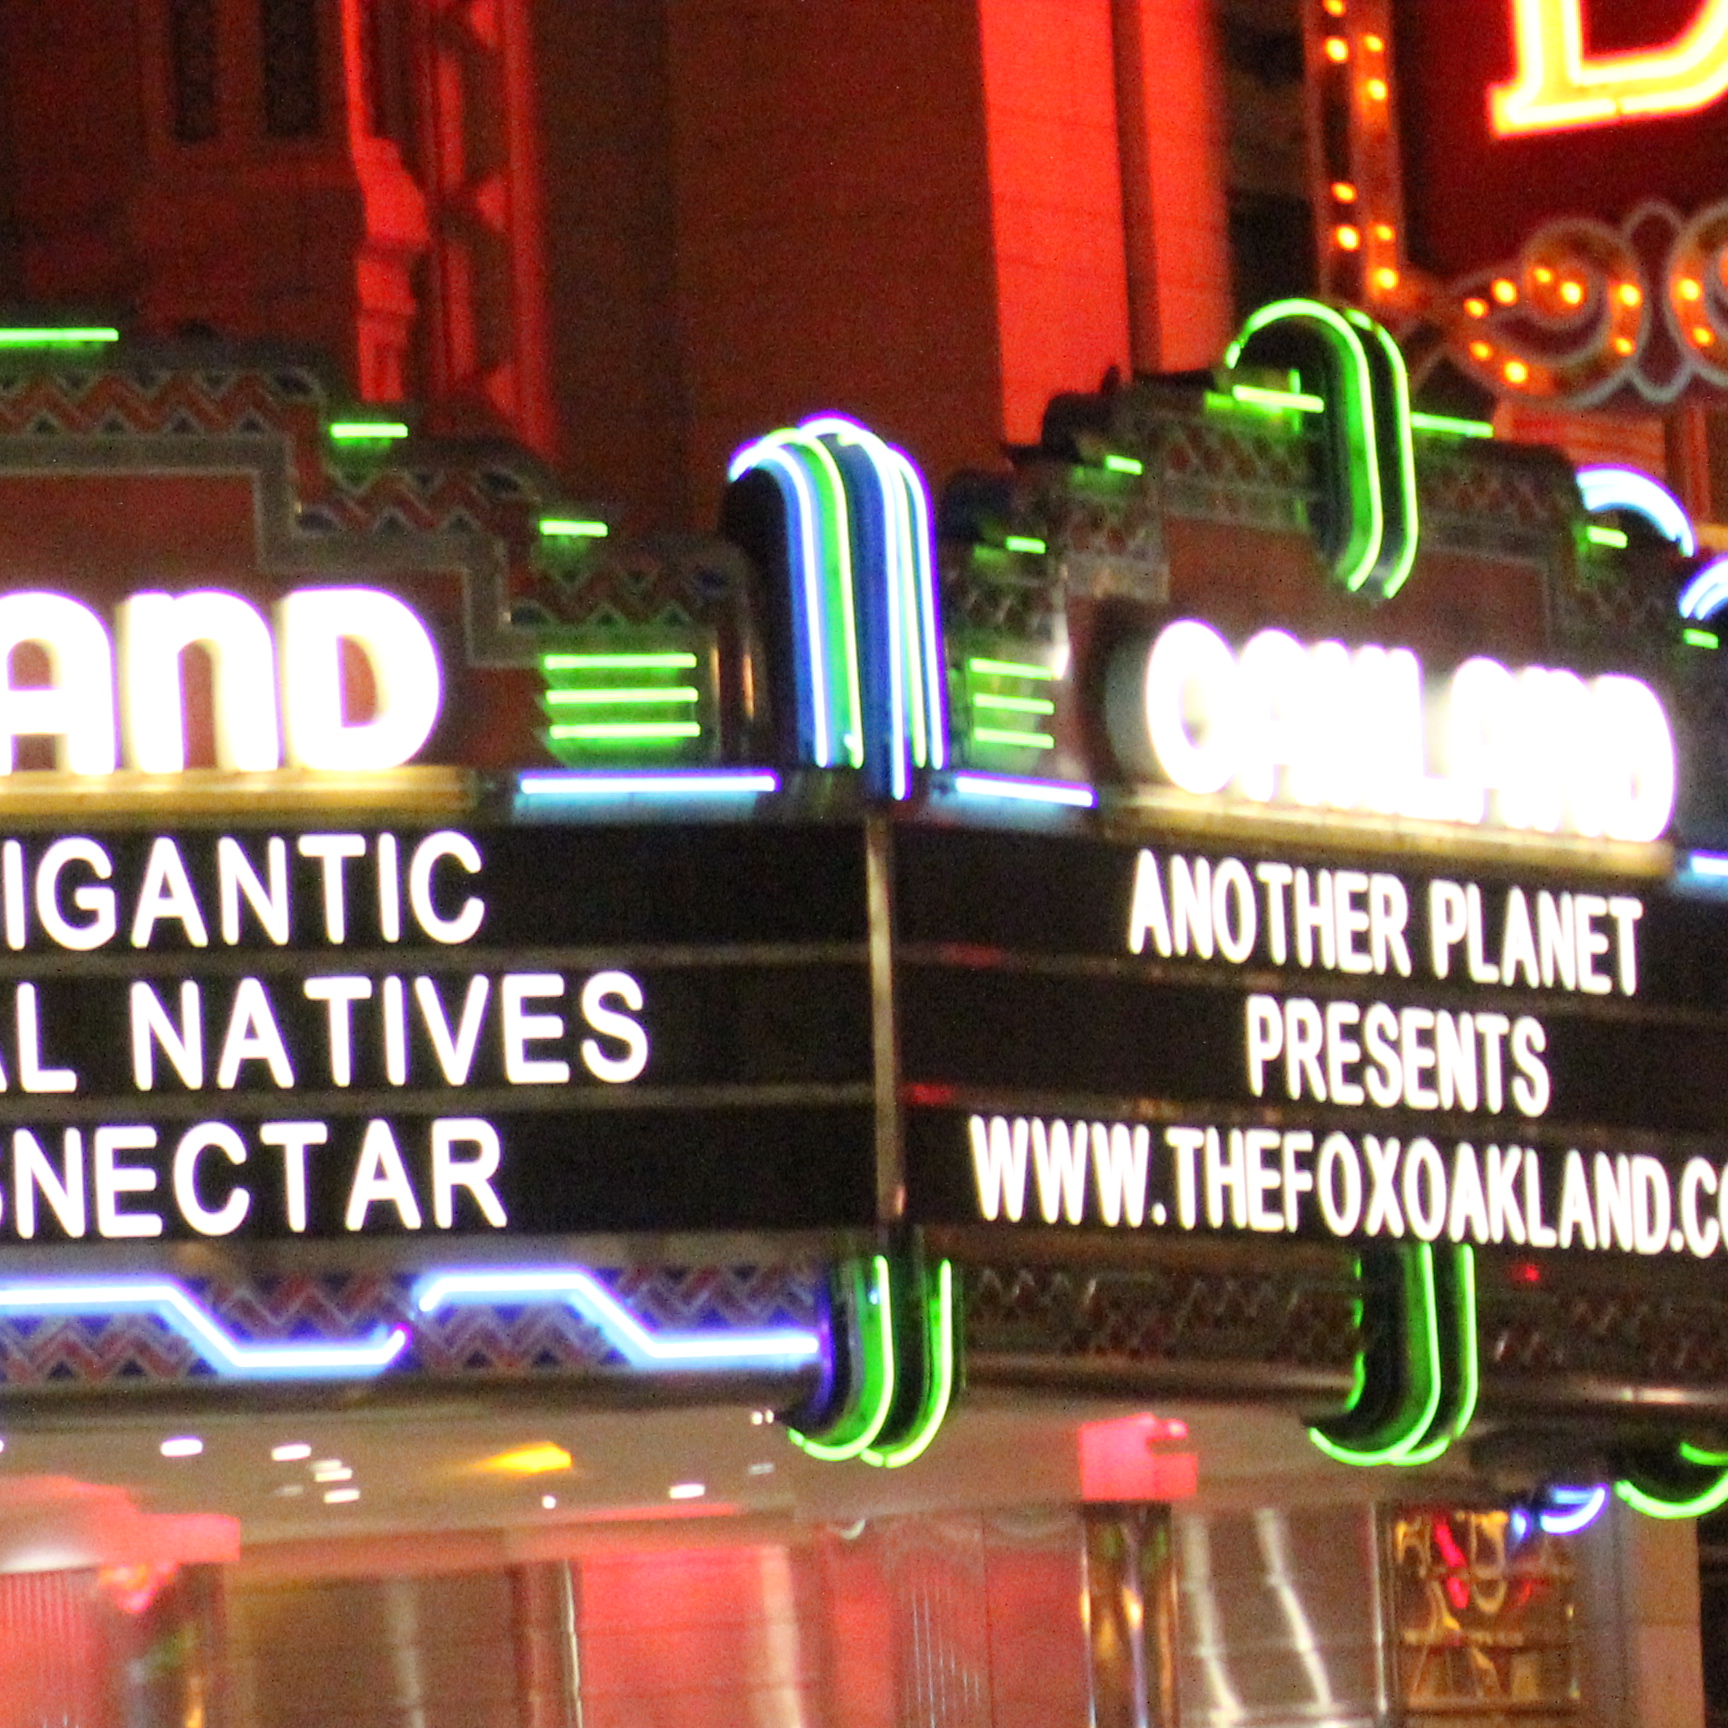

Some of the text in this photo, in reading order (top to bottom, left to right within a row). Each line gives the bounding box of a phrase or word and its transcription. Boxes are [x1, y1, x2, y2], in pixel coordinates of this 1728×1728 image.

[1129, 849, 1644, 997] ANOTHER PLANET
[130, 971, 649, 1091] NATIVES
[1247, 994, 1551, 1117] PRESENTS
[969, 1114, 1728, 1259] WWW.THEFOXOAKLAND.C
